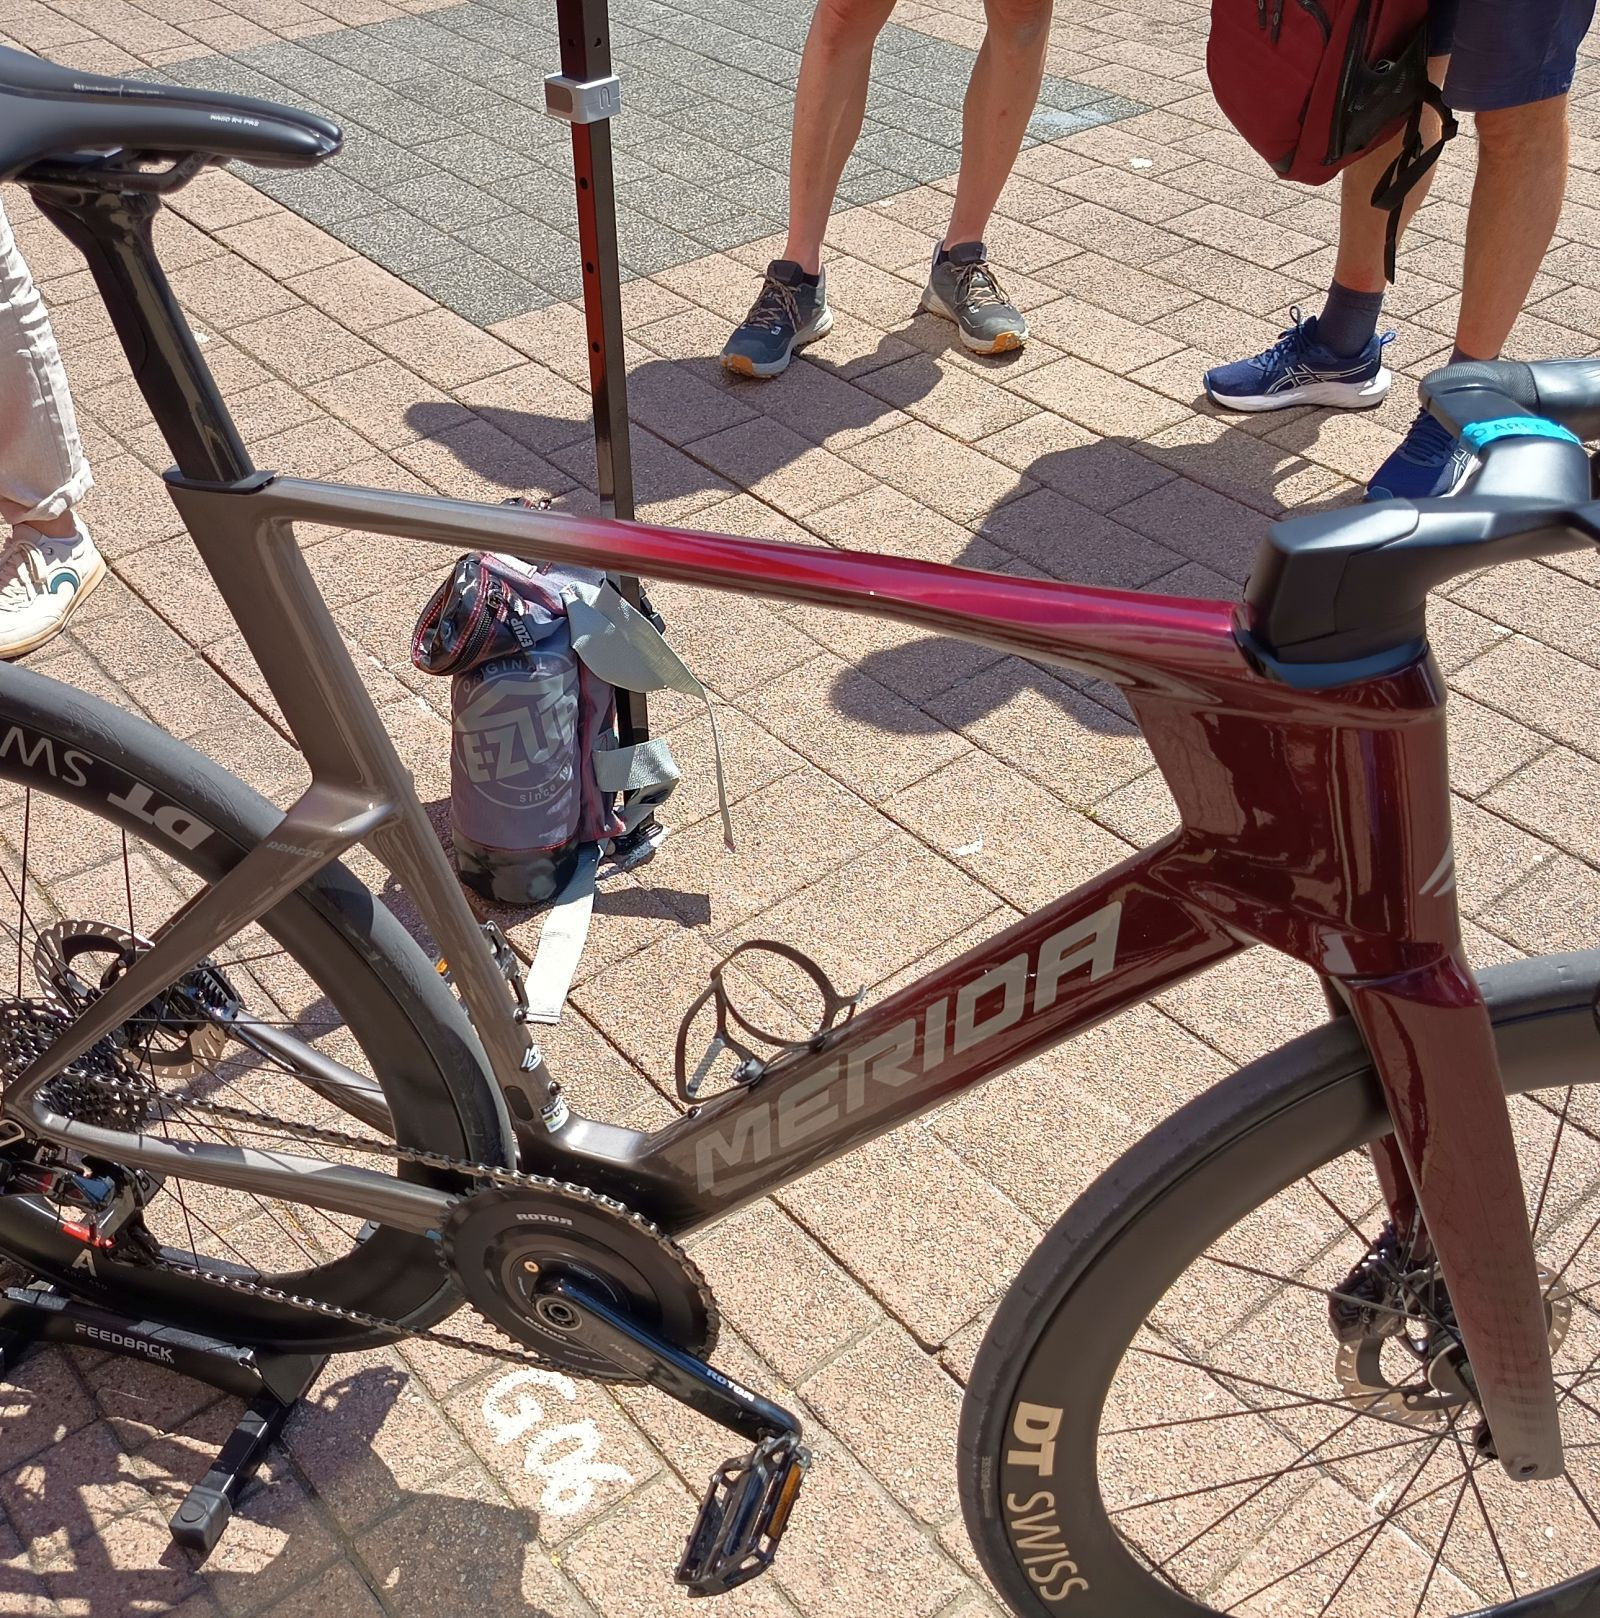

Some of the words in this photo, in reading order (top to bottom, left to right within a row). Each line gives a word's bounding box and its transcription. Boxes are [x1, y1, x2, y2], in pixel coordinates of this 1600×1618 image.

[107, 782, 216, 850] DT
[694, 901, 1124, 1197] MERIDA
[75, 1323, 173, 1360] FEEDBACK
[1006, 1401, 1064, 1477] DT
[1007, 1491, 1090, 1602] SWISS
